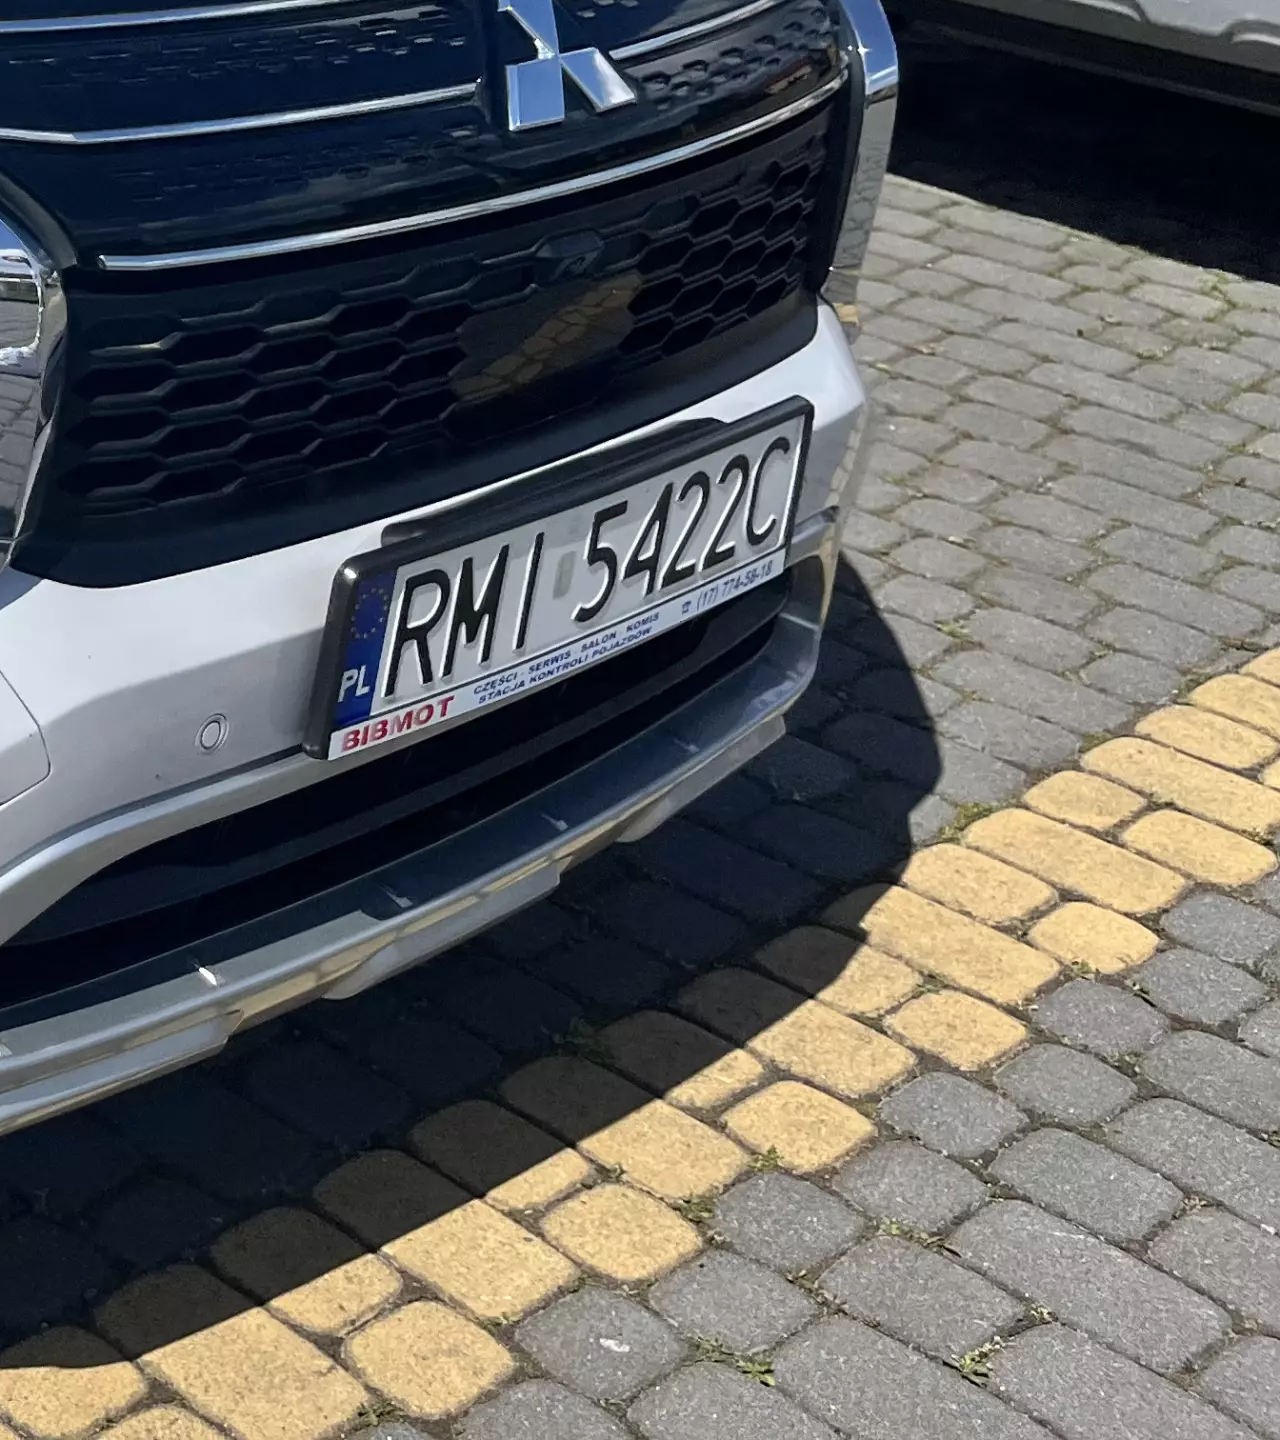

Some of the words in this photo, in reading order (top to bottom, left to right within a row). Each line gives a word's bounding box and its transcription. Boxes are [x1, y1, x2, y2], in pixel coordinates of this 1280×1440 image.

[383, 531, 544, 699] RMI
[572, 436, 790, 624] 5422C
[478, 680, 526, 705] STACJA
[529, 654, 589, 684] KONTROLI
[591, 625, 653, 659] POJAZDÓW
[527, 649, 572, 675] SERWIS
[580, 630, 618, 653] SALON
[625, 611, 661, 634] KOMIS
[337, 664, 371, 703] PL
[341, 695, 456, 753] BIBMOT
